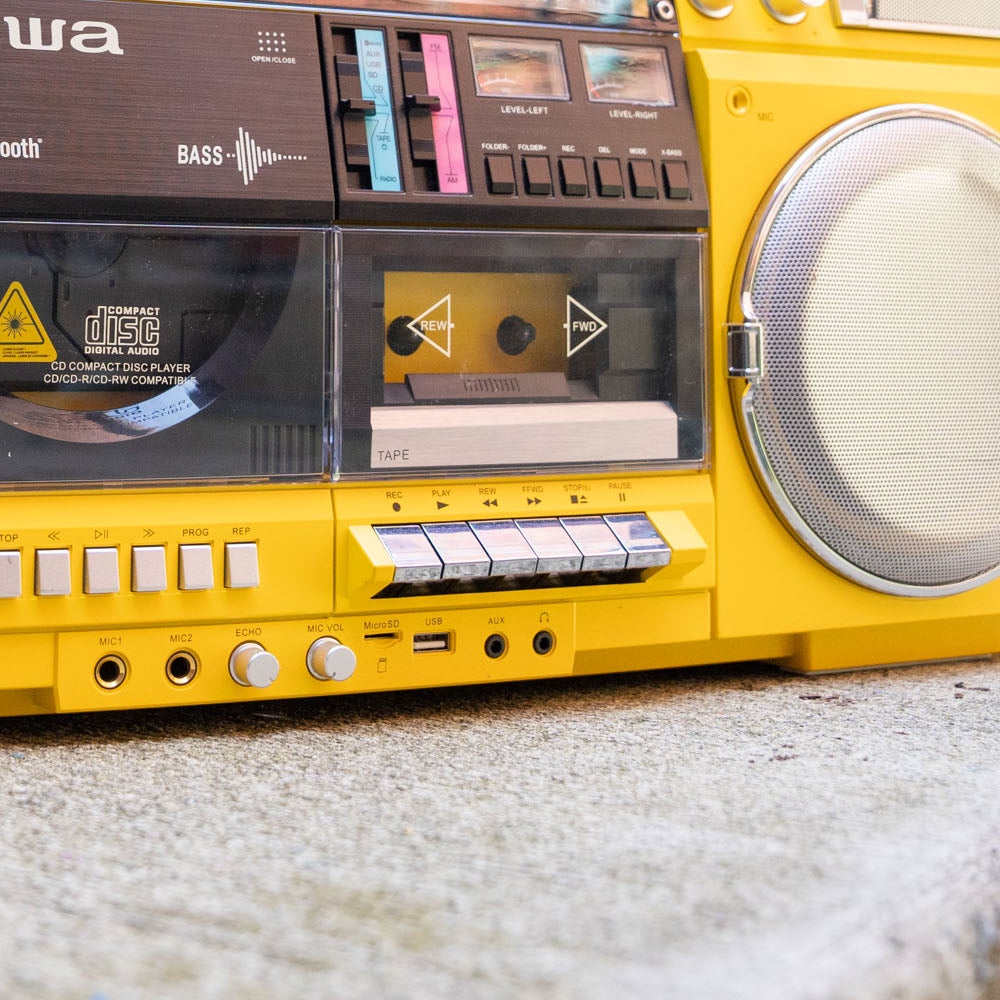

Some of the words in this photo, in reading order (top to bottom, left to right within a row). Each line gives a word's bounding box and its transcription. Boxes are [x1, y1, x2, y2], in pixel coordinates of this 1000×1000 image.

[500, 104, 549, 115] LEVEL-LEFT
[609, 109, 659, 120] LEVEL-RIGHT
[757, 112, 774, 123] MIC
[376, 134, 392, 143] TAPE
[517, 143, 547, 152] FOLDER+
[561, 145, 576, 153] REC
[598, 146, 611, 154] DEL
[629, 147, 648, 156] MODE
[177, 143, 223, 166] BASS
[447, 176, 458, 184] AM
[107, 305, 160, 316] COMPACT
[420, 320, 447, 331] REW
[572, 320, 597, 332] FWD
[84, 346, 124, 355] DIGITAL
[127, 347, 160, 356] AUDIO
[50, 361, 67, 371] CD
[68, 361, 121, 372] COMPACT
[122, 362, 149, 373] DISC
[150, 363, 191, 373] PLAYER
[43, 373, 130, 385] CD/CD-R/CD-RW
[377, 449, 410, 461] TAPE
[522, 485, 544, 494] FFWD
[608, 482, 633, 490] PAUSE
[386, 490, 403, 499] REC
[432, 488, 451, 497] PLAY
[478, 487, 497, 496] REW
[182, 528, 209, 537] PROG
[232, 526, 251, 535] REP
[363, 618, 400, 630] MicroSD
[425, 616, 444, 626] USB
[487, 616, 506, 625] AUX
[235, 627, 263, 637] ECHO
[306, 624, 325, 633] MIC
[326, 622, 345, 632] VOL
[99, 637, 123, 646] MIC1
[169, 633, 193, 643] MIC2
